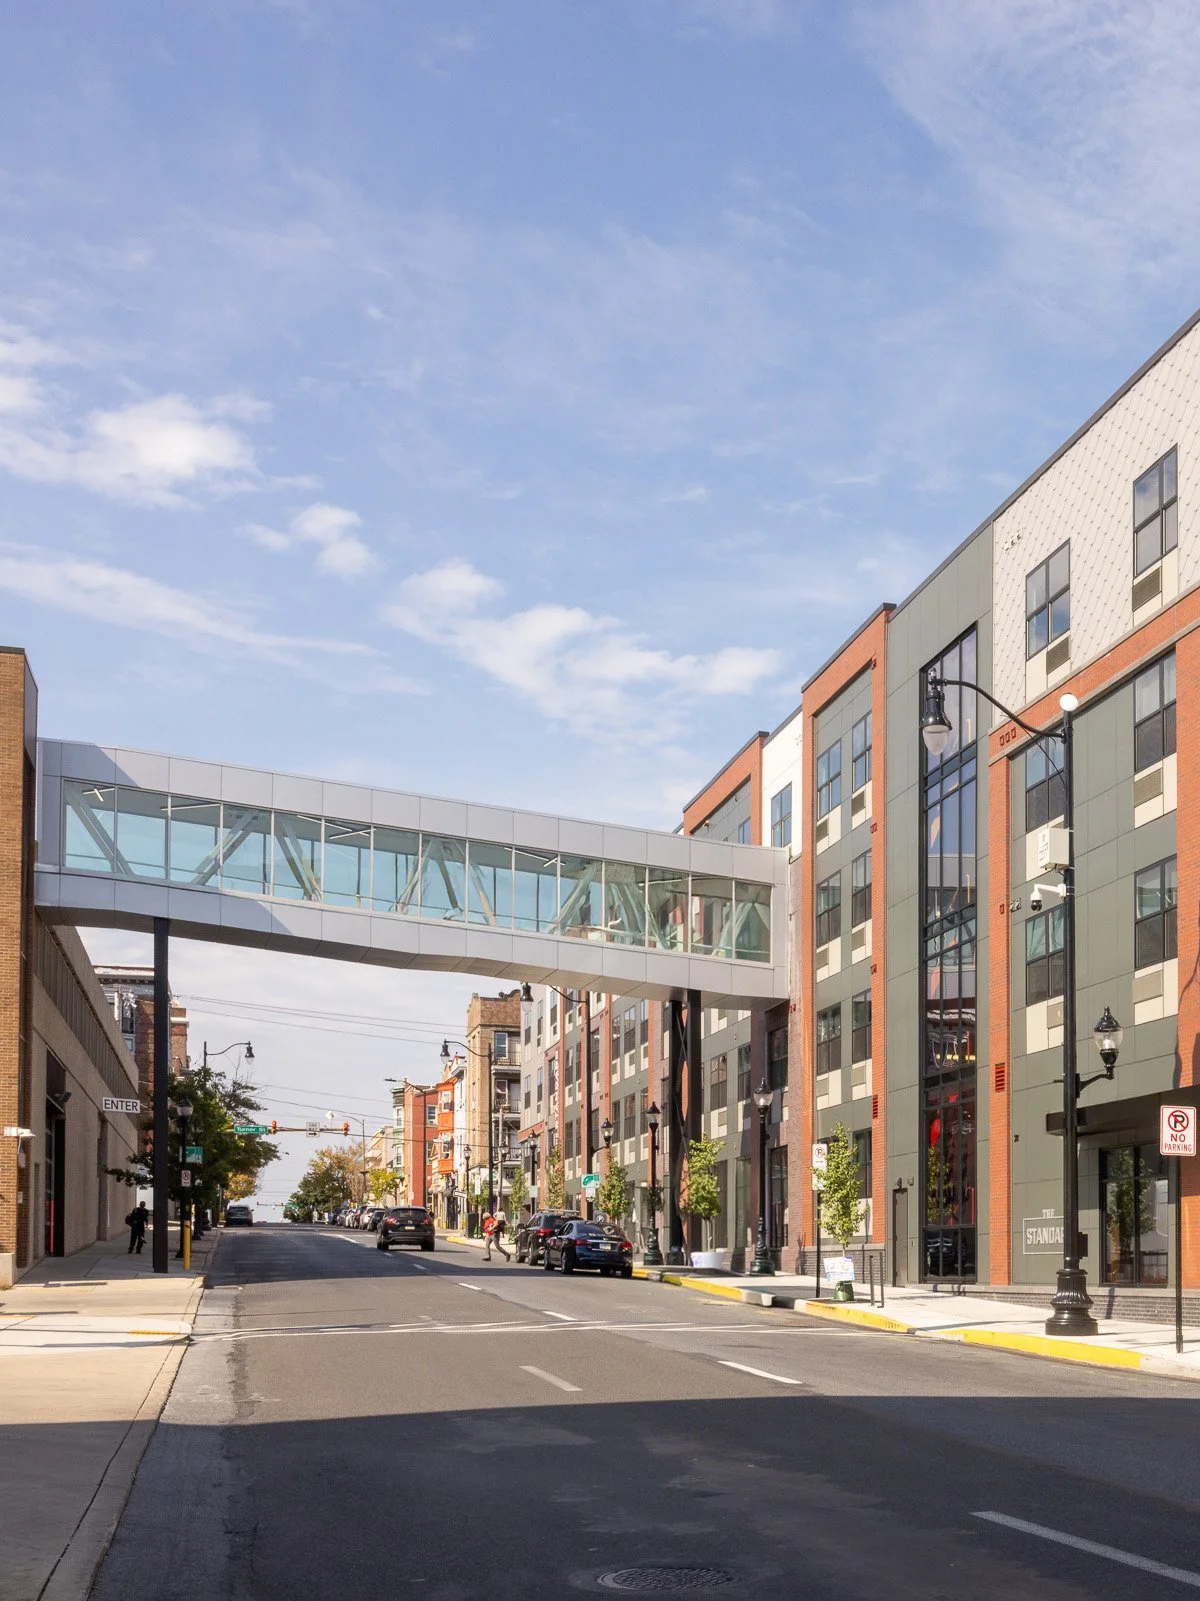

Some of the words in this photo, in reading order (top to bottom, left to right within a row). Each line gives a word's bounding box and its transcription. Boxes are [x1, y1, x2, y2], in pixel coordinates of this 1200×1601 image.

[104, 1098, 138, 1111] ENTER
[1170, 1133, 1186, 1142] NO
[1164, 1143, 1192, 1152] PARKING
[1041, 1208, 1055, 1219] THE
